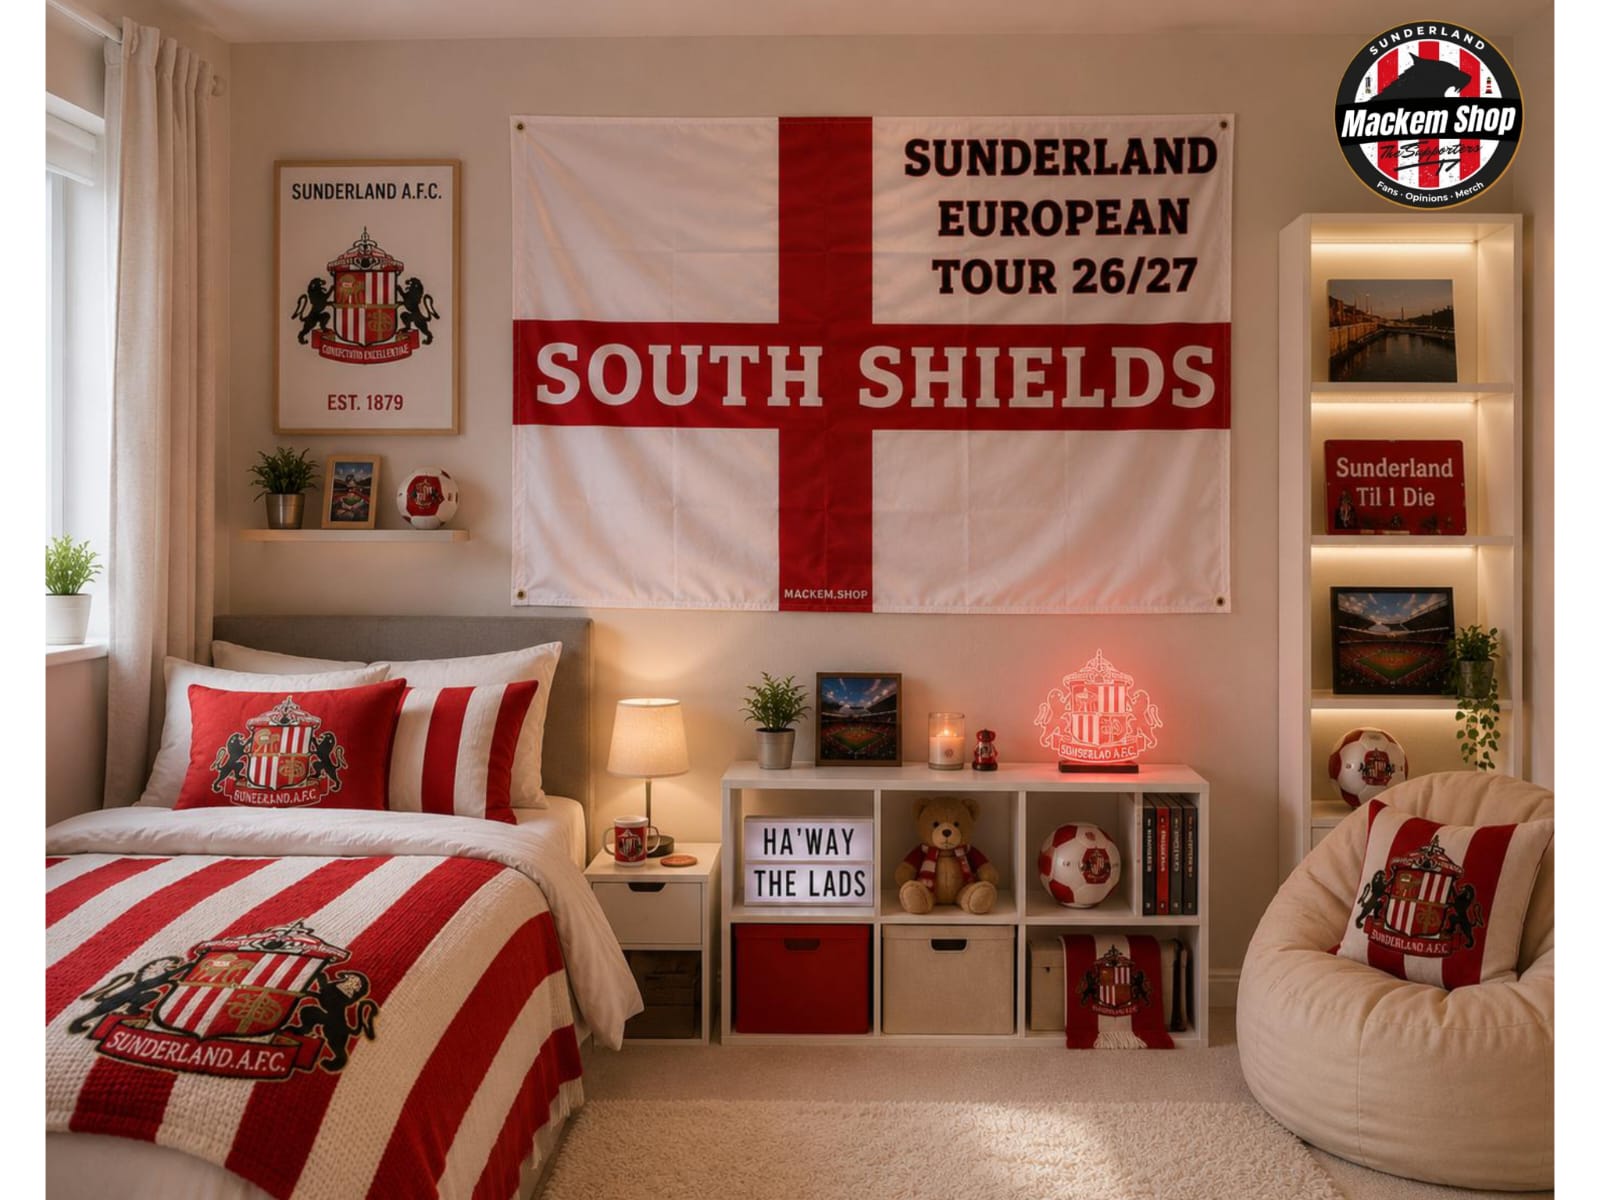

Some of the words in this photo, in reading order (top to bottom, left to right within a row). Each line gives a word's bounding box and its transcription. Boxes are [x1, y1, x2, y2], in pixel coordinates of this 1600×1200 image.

[904, 137, 1218, 177] SUNDERLAND
[291, 183, 397, 200] SUNDERLAND
[402, 182, 442, 200] A.F.C.
[938, 198, 1190, 237] EUROPEAN
[932, 258, 1057, 294] TOUR
[1072, 256, 1198, 294] 26/27
[535, 341, 823, 408] SOUTH
[858, 344, 1217, 409] SHIELDS
[328, 394, 361, 411] EST.
[366, 394, 404, 411] 1879
[1336, 457, 1454, 478] Sunderland
[1356, 487, 1381, 507] Til
[1403, 487, 1435, 507] Die
[784, 588, 869, 600] MACKEM.SHOP
[763, 827, 855, 855] HA'WAY
[753, 869, 797, 897] THE
[808, 869, 866, 898] LADS
